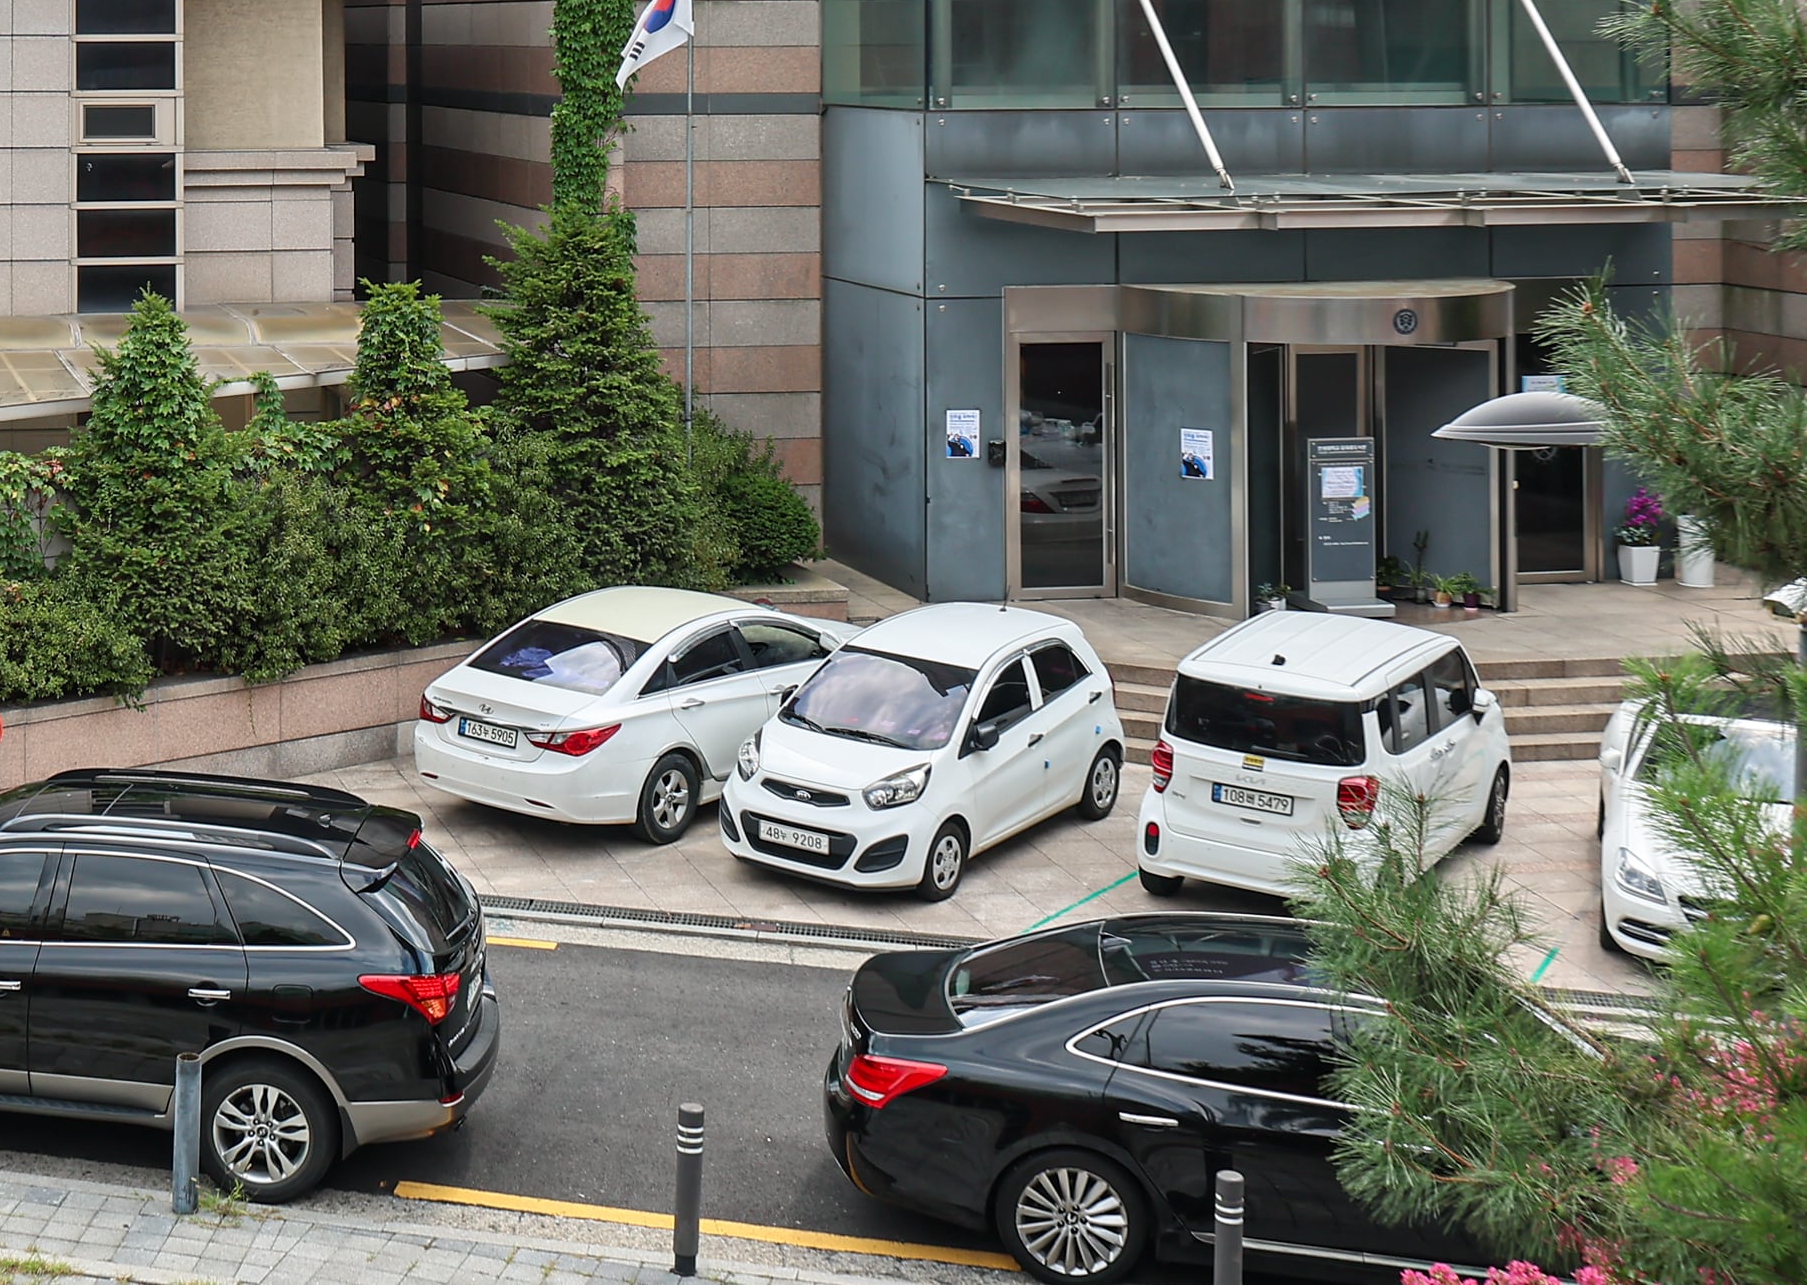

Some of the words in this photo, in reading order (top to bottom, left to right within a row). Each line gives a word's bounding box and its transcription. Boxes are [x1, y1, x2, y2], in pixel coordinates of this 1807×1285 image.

[1257, 795, 1289, 811] 5479
[766, 826, 787, 841] 48누
[792, 832, 823, 850] 9208
